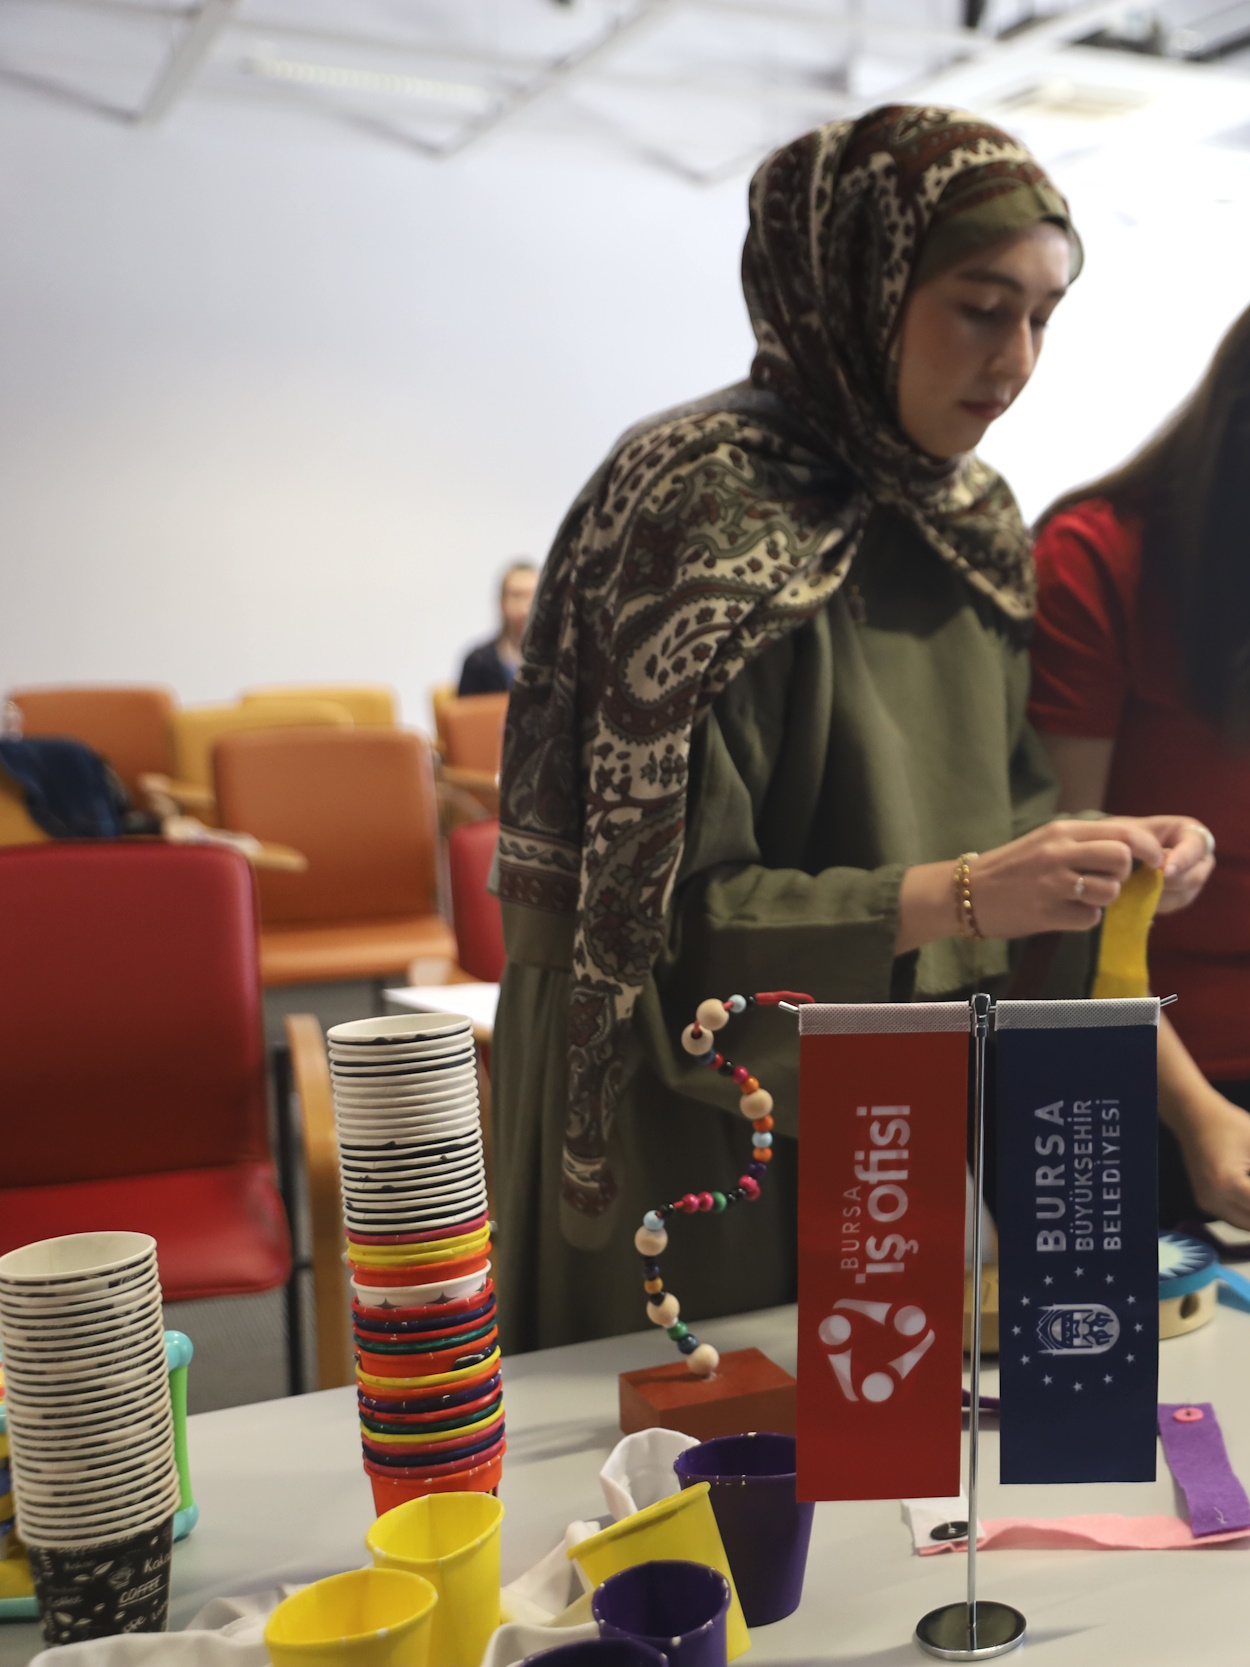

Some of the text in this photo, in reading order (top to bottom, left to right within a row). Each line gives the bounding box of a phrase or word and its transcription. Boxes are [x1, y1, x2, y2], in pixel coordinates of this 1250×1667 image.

[841, 1185, 862, 1270] BURSA
[1033, 1099, 1067, 1252] BURSA
[1095, 1099, 1122, 1251] BELEDİYESİ
